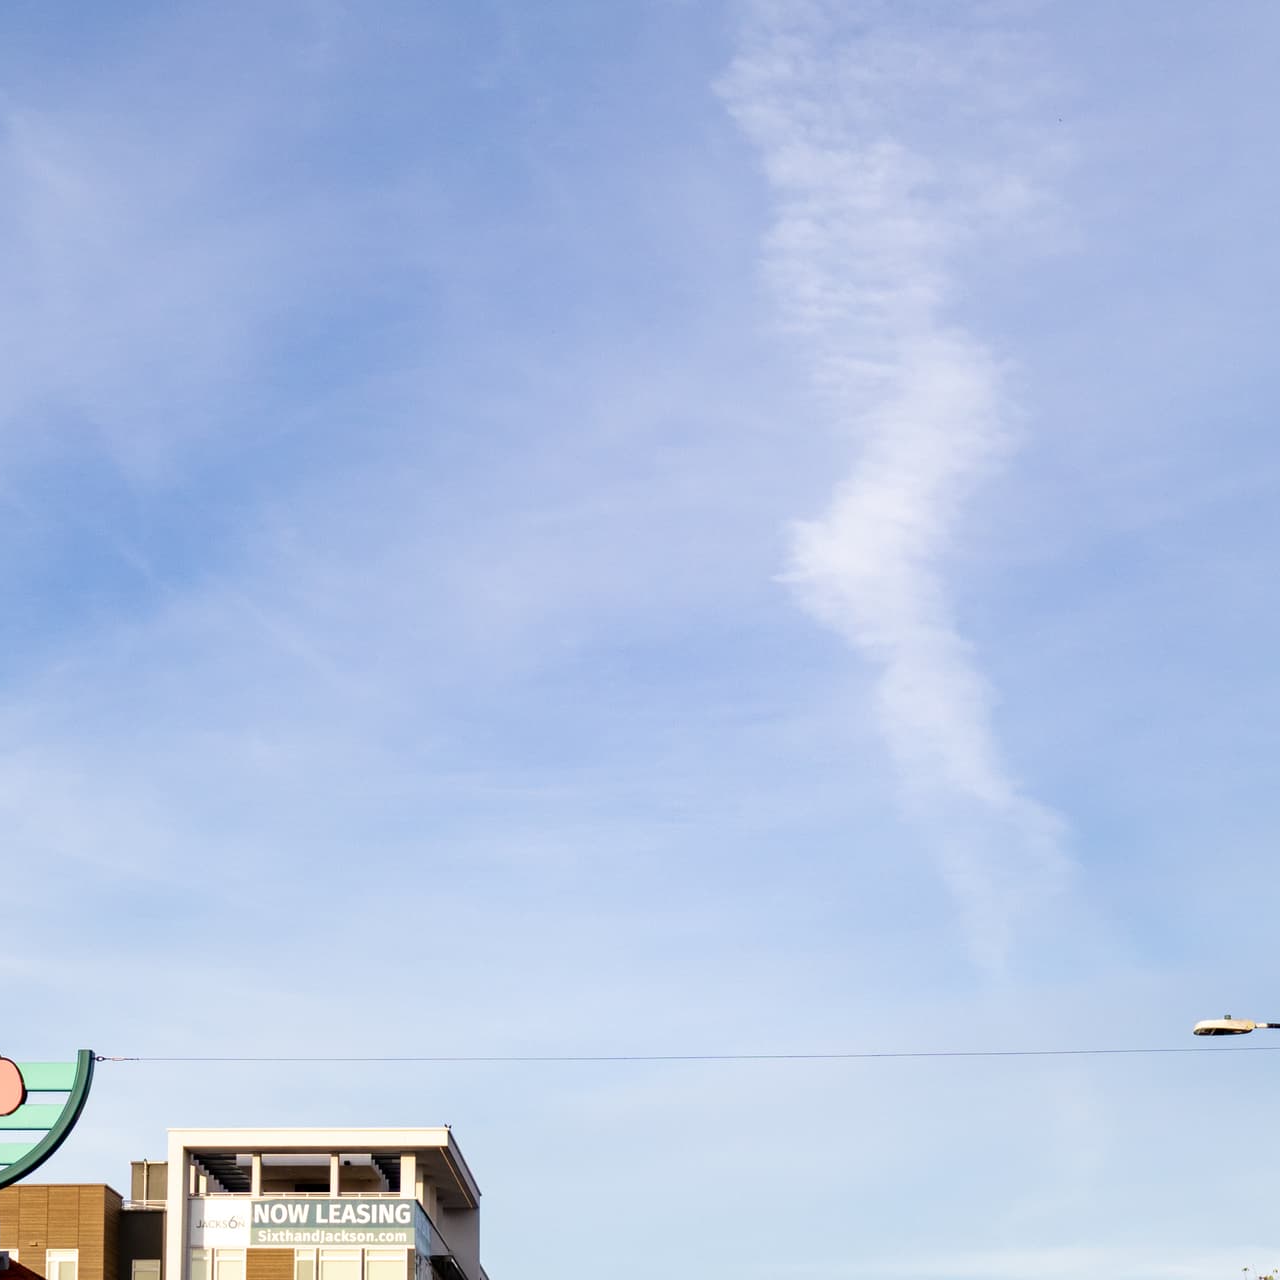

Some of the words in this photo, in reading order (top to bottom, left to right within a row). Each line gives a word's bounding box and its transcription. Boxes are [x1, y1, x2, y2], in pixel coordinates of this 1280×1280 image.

[253, 1204, 309, 1224] NOW
[316, 1203, 411, 1224] LEASING
[257, 1229, 407, 1243] SixthandJackson.com
